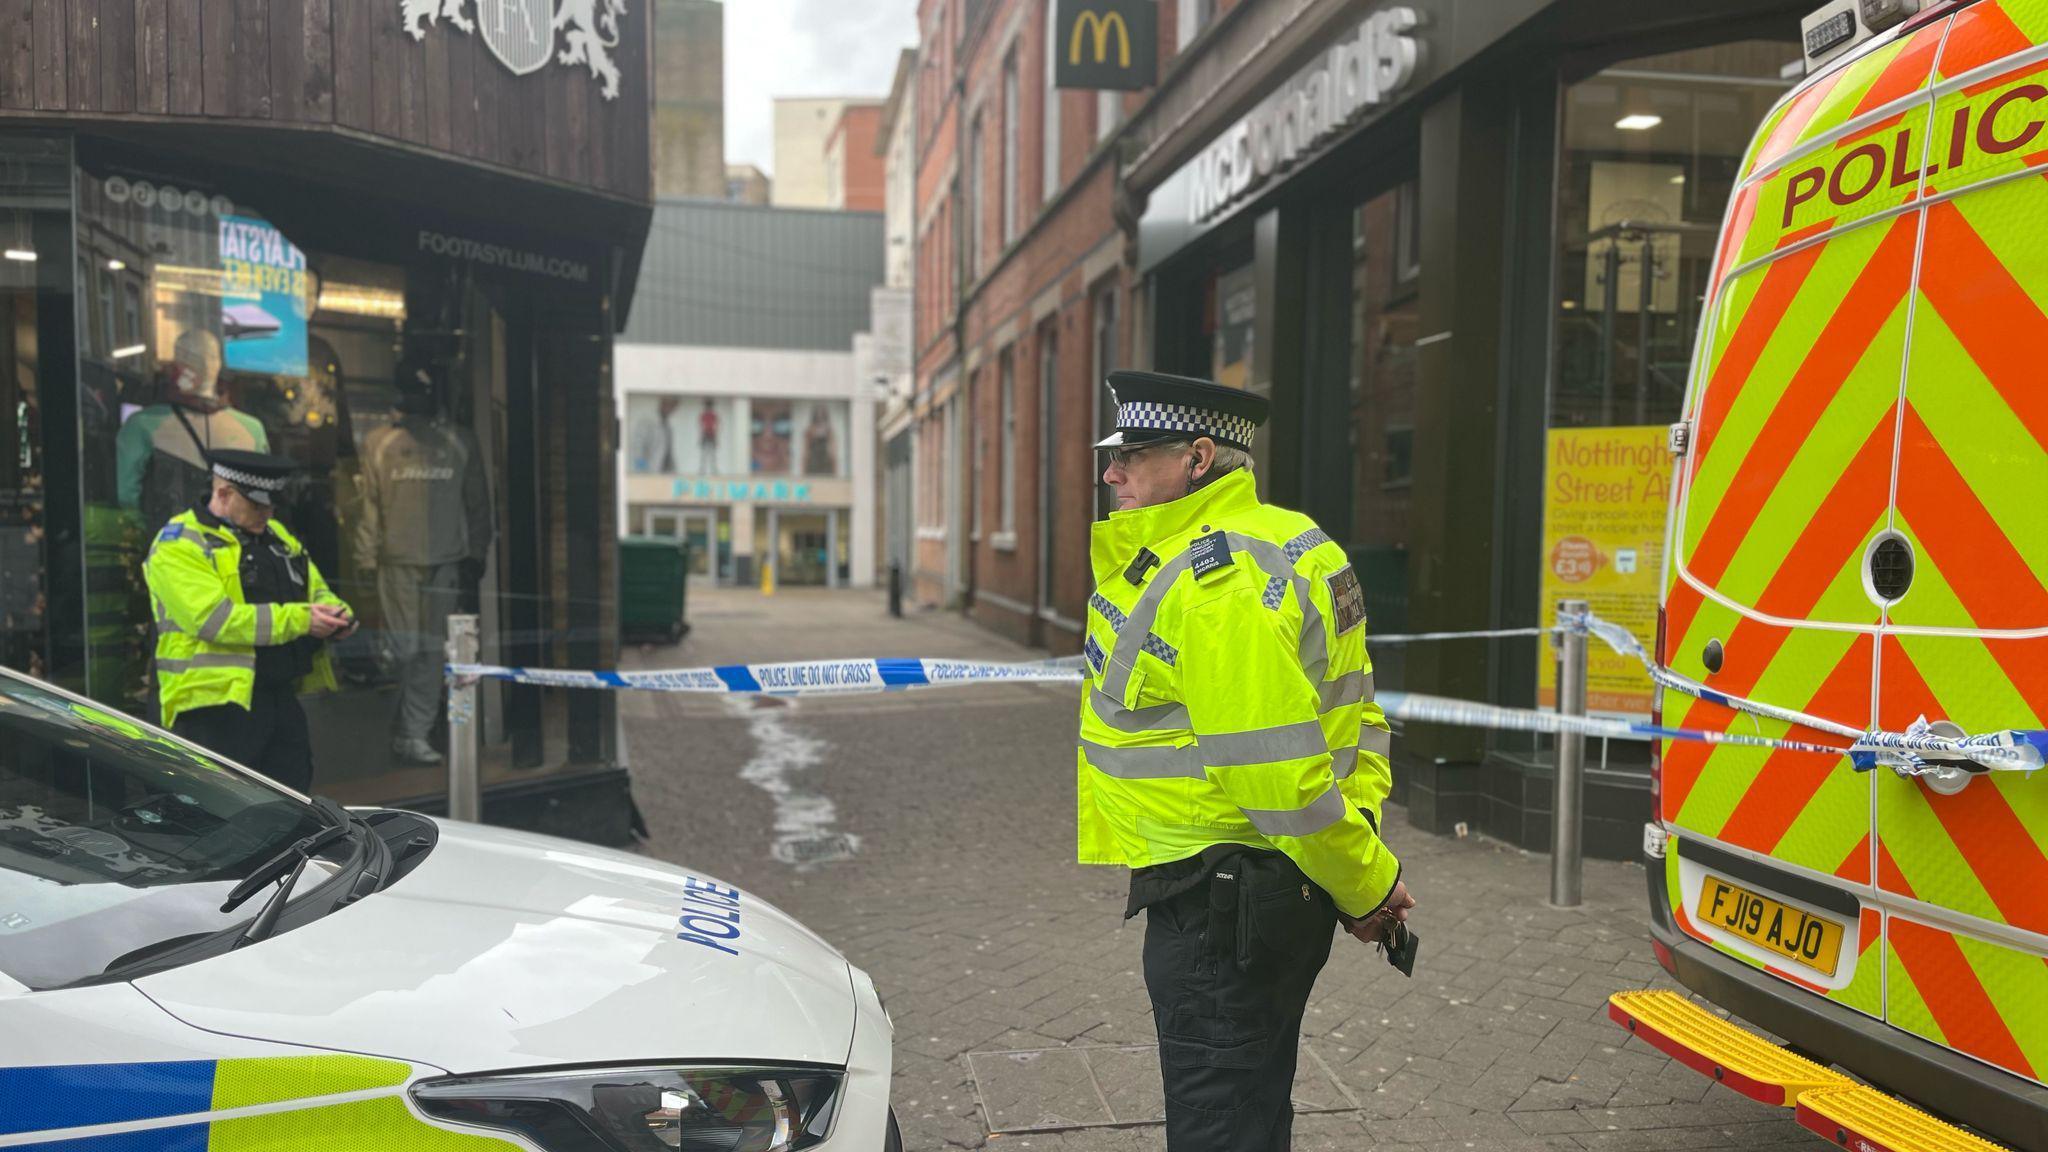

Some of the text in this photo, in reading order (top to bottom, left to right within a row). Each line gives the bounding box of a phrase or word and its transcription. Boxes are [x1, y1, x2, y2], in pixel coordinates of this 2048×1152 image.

[418, 230, 588, 282] FOOTASYLUM.COM
[672, 478, 812, 501] PRIMARK
[1555, 472, 1634, 505] Street
[758, 663, 872, 687] POLICE LINE DO NOT CROSS
[677, 876, 740, 956] POLICE
[1709, 883, 1824, 960] FJ19 AJO
